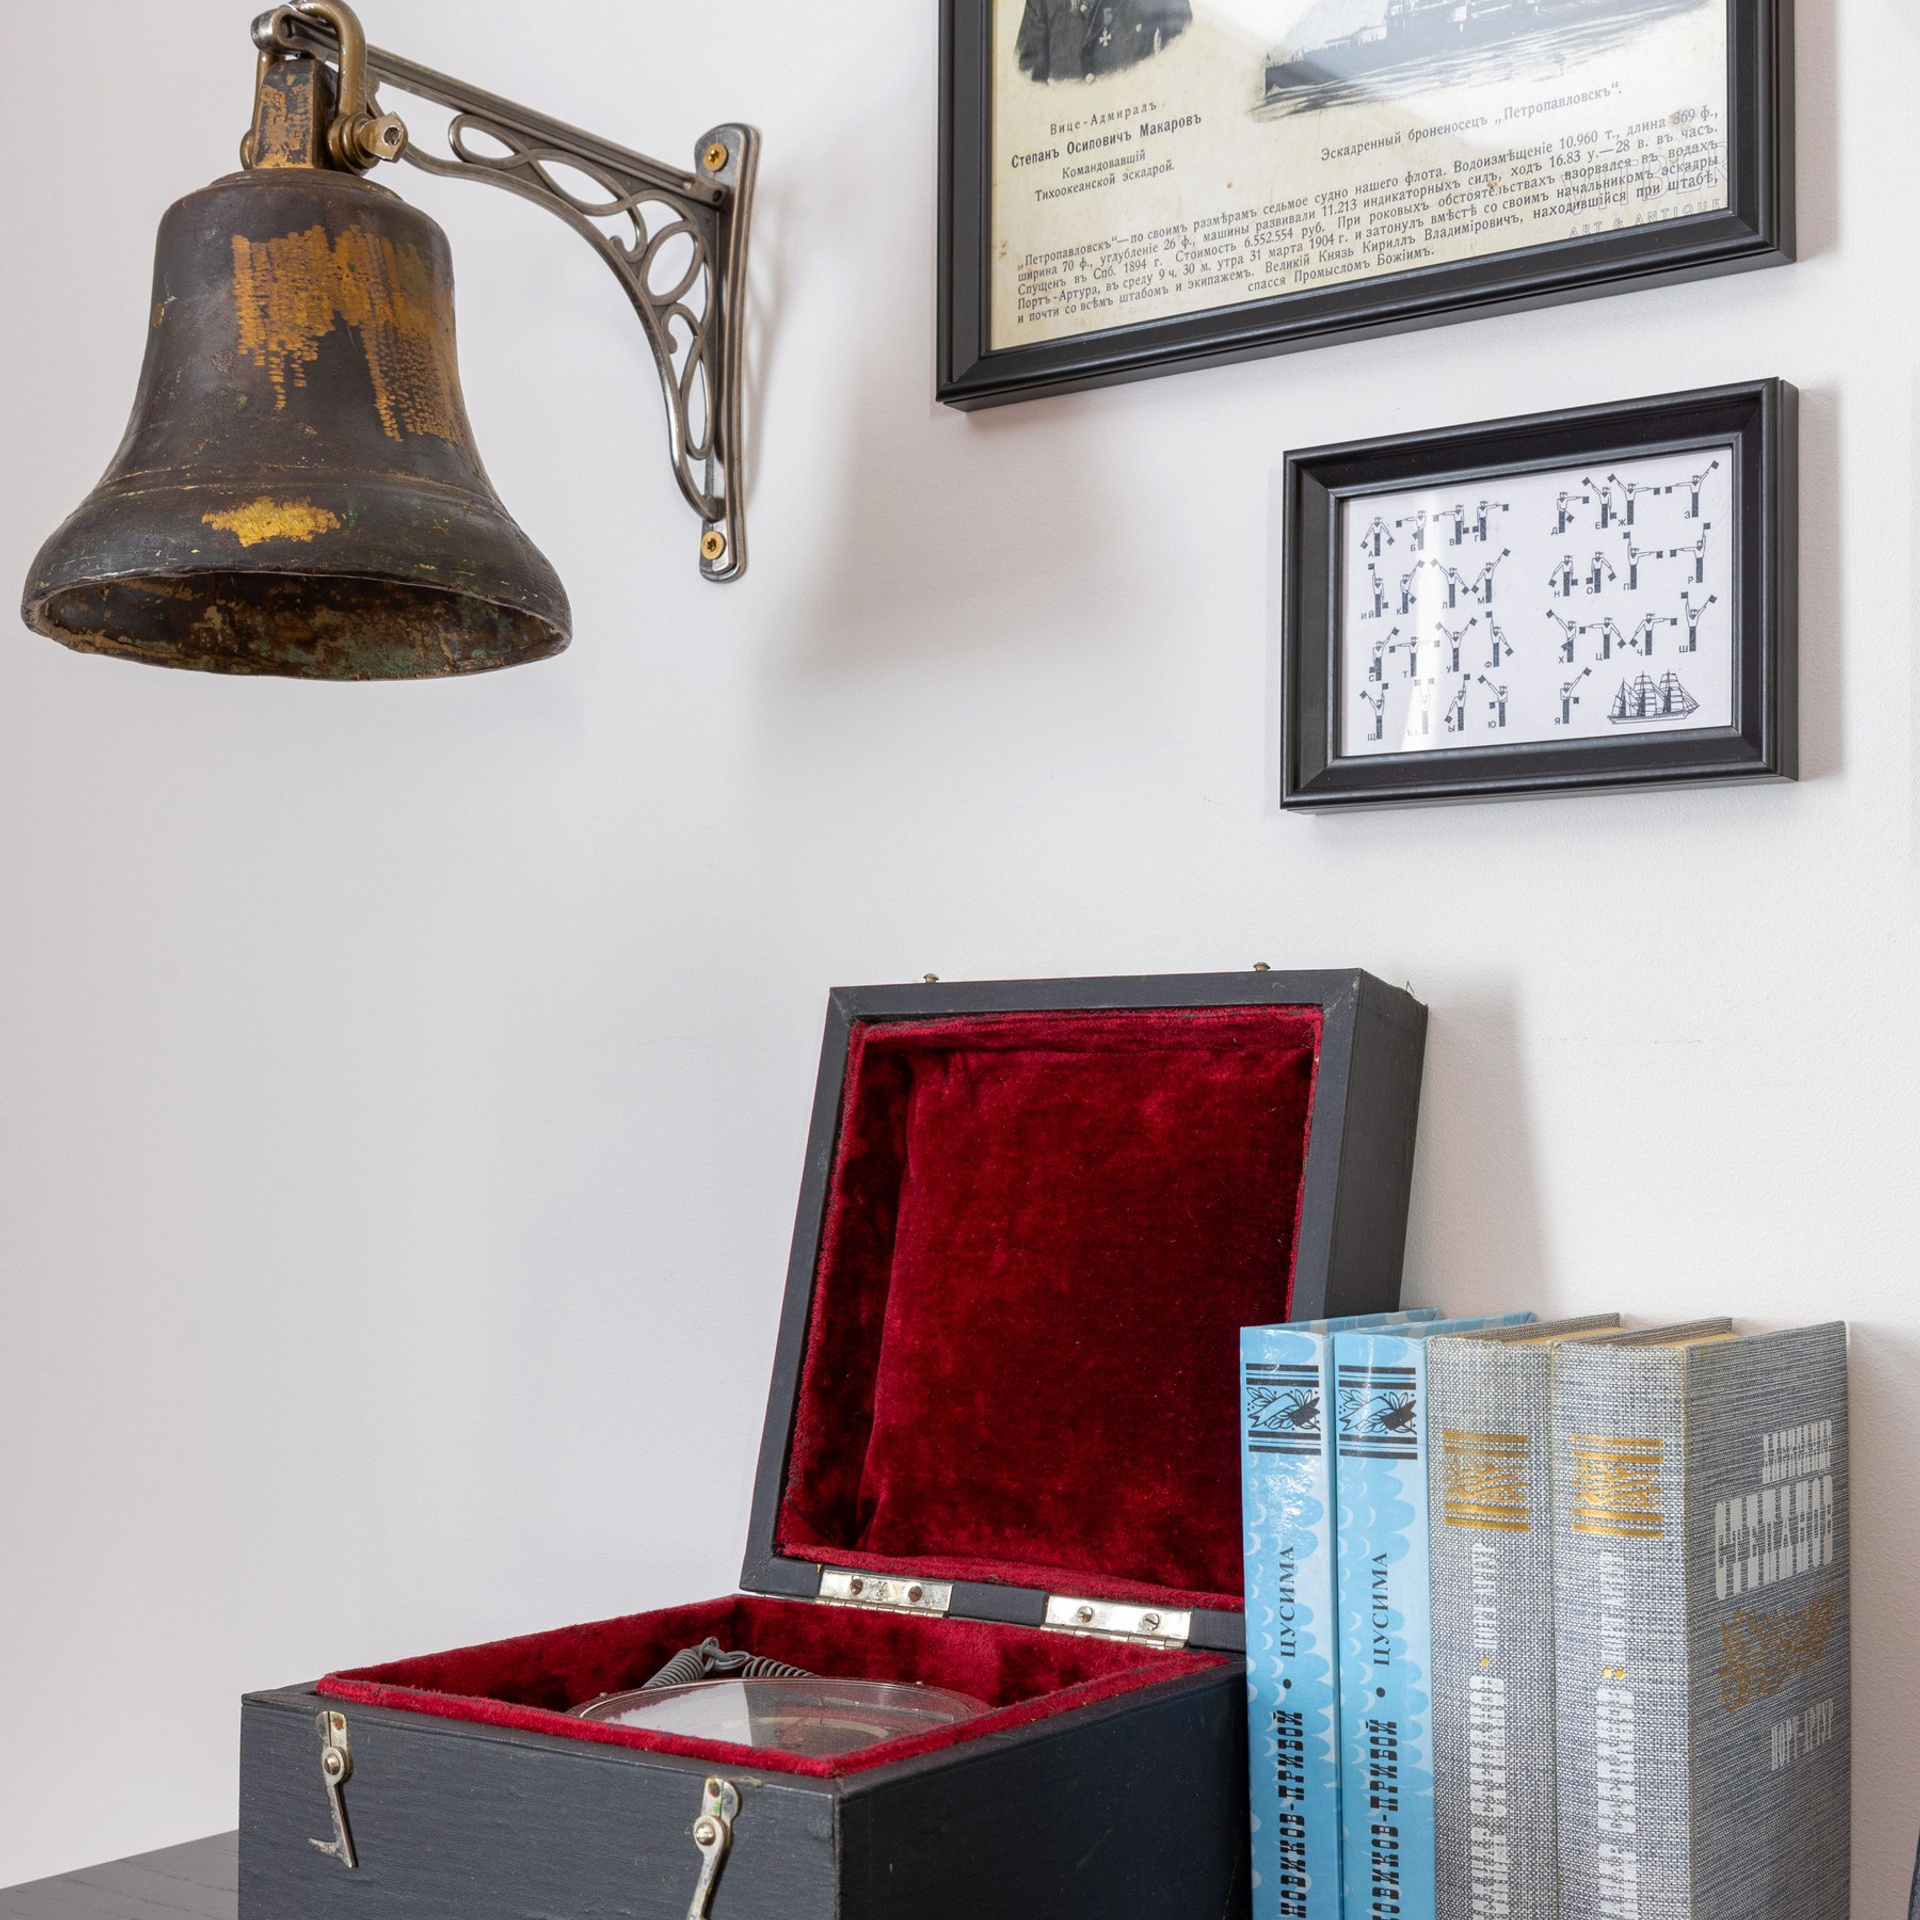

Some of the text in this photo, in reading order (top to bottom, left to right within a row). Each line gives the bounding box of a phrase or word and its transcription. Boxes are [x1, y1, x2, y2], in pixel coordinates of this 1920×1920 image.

[1011, 113, 1202, 169] Степанъ Осиповичъ Макаровъ
[1320, 132, 1401, 161] Эскадренный
[1407, 114, 1488, 142] броненосецъ
[1147, 224, 1187, 240] своимъ
[1263, 197, 1309, 215] седьмое
[1314, 188, 1349, 205] судно
[1355, 177, 1398, 195] нашего
[1404, 169, 1446, 186] флота.
[1559, 131, 1598, 150] 10.960
[1626, 118, 1666, 136] длина
[1672, 108, 1695, 125] 369
[1034, 159, 1175, 202] Тихоокеанской эскадрой.
[1017, 266, 1058, 282] ширина
[1063, 260, 1074, 272] 70
[1163, 238, 1176, 251] 26
[1203, 225, 1250, 242] машины
[1255, 210, 1316, 234] развивали
[1322, 199, 1357, 217] 11.213
[1363, 180, 1461, 208] индикаторныхъ
[1510, 162, 1543, 177] ходъ
[1549, 150, 1581, 169] 16.83
[1656, 134, 1673, 145] въ
[1681, 124, 1718, 139] часъ.
[1635, 197, 1728, 224] ANTIQUE
[1018, 280, 1066, 296] Спущенъ
[1074, 273, 1087, 284] въ
[1093, 267, 1116, 280] Спб.
[1124, 258, 1147, 273] 1894
[1154, 257, 1163, 267] г.
[1175, 242, 1237, 263] Стоимость
[1243, 227, 1294, 248] 6.552.554
[1301, 222, 1325, 239] руб.
[1337, 214, 1361, 230] При
[1369, 202, 1429, 224] роковыхъ
[1564, 156, 1631, 181] взорвался
[1641, 152, 1658, 164] въ
[1668, 141, 1718, 159] водахъ
[1105, 281, 1119, 292] въ
[1122, 273, 1153, 290] среду
[1159, 269, 1165, 280] 9
[1168, 268, 1177, 279] ч.
[1183, 263, 1195, 276] 30
[1200, 262, 1211, 272] м.
[1217, 254, 1244, 272] утра
[1250, 250, 1261, 262] 31
[1268, 243, 1303, 258] марта
[1310, 233, 1335, 250] 1904
[1338, 235, 1348, 244] г.
[1355, 230, 1362, 241] и
[1366, 217, 1424, 239] затонулъ
[1483, 202, 1498, 214] со
[1502, 191, 1549, 210] своимъ
[1556, 169, 1654, 199] начальникомъ
[1661, 155, 1718, 176] эскадры
[1017, 314, 1024, 324] и
[1029, 306, 1060, 322] почти
[1065, 304, 1077, 314] со
[1119, 284, 1169, 303] штабомъ
[1175, 282, 1182, 292] и
[1188, 268, 1255, 290] экипажемъ.
[1319, 248, 1354, 263] Князь
[1362, 233, 1416, 254] Кириллъ
[1636, 182, 1660, 198] при
[1247, 276, 1286, 292] спасся
[1294, 257, 1371, 284] Промысломъ
[1684, 511, 1691, 519] З
[1595, 522, 1601, 530] Е
[1617, 518, 1627, 527] Ж
[1550, 527, 1559, 536] Д
[1449, 538, 1455, 547] В
[1474, 535, 1480, 543] Г
[1410, 543, 1416, 552] Б
[1688, 576, 1694, 584] Р
[1586, 587, 1594, 595] О
[1623, 582, 1630, 591] П
[1554, 589, 1560, 598] Н
[1441, 601, 1448, 610] Л
[1477, 597, 1485, 605] М
[1360, 610, 1374, 620] И Й
[1396, 607, 1402, 616] К
[1637, 648, 1643, 656] Ч
[1679, 645, 1688, 653] Ш
[1558, 656, 1565, 664] Х
[1595, 652, 1603, 661] Ц
[1446, 665, 1452, 673] У
[1484, 661, 1493, 669] Ф
[1368, 673, 1375, 682] С
[1402, 670, 1408, 679] Т
[1487, 720, 1497, 729] Ю
[1554, 717, 1561, 725] Я
[1448, 724, 1455, 733] Ы
[1367, 733, 1376, 742] Щ
[1715, 1475, 1834, 1600] СТЕПАНОВ
[1372, 1552, 1390, 1666] ЦУСИМА
[1273, 1546, 1307, 1919] НОВИКОВ-ПРИБОЙ ЦУСИМА
